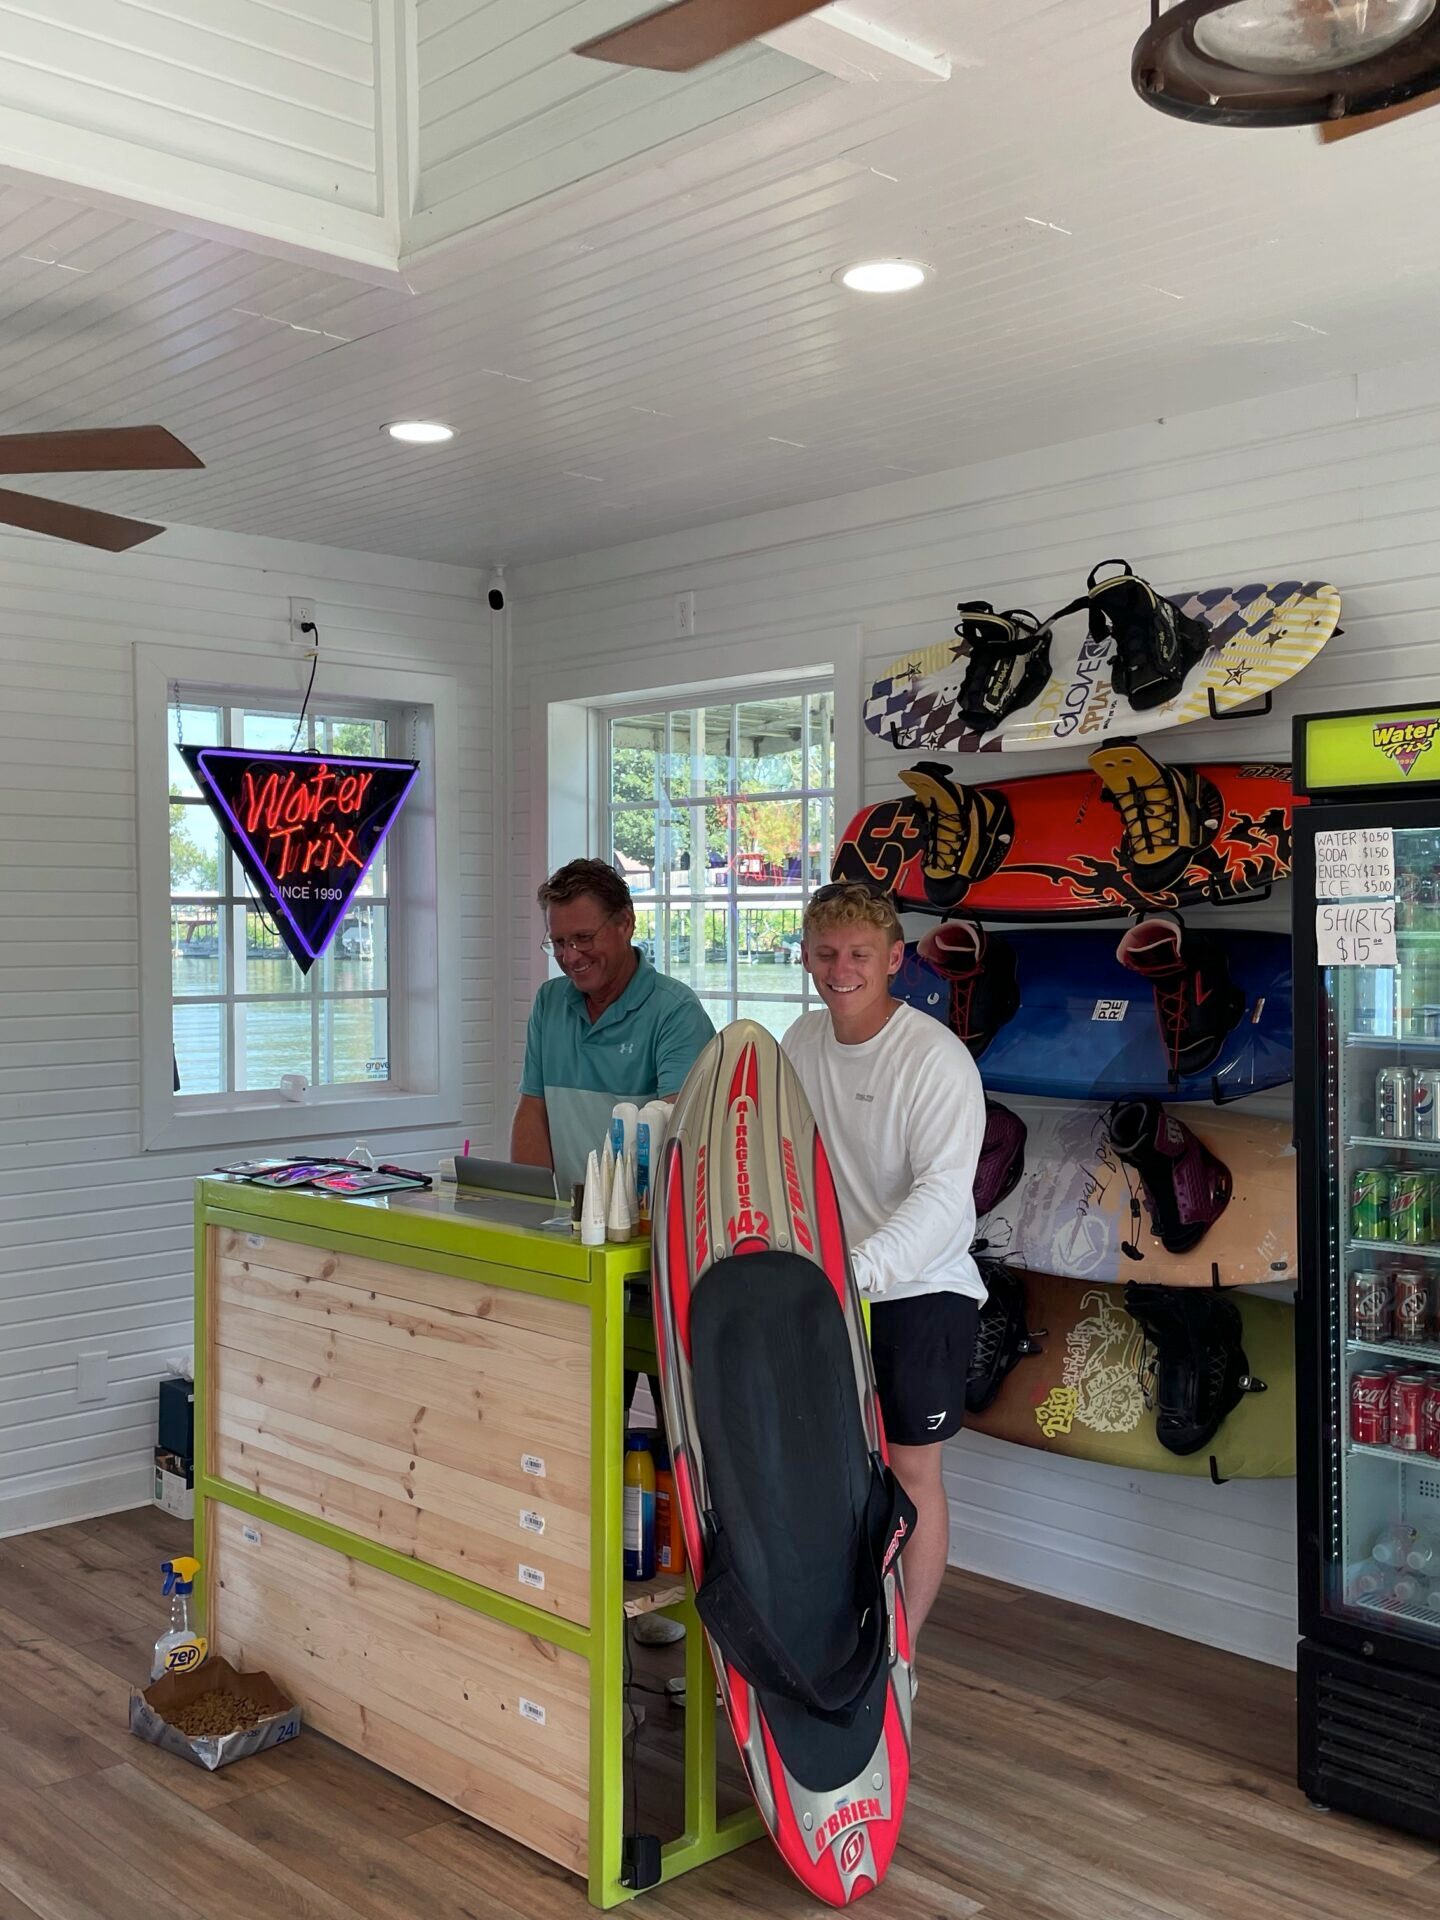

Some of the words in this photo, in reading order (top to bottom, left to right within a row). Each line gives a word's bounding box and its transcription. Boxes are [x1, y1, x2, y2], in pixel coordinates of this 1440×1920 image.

[1025, 678, 1071, 741] BODY
[1054, 660, 1101, 737] GLOVE
[1079, 681, 1112, 734] SPLAT
[1373, 722, 1438, 747] Water
[1382, 740, 1432, 758] Trix
[245, 763, 374, 832] Water
[269, 822, 364, 880] Trix
[1316, 832, 1357, 846] WATER
[1362, 831, 1389, 843] $0.50
[1318, 848, 1348, 862] SODA
[1318, 863, 1361, 879] ENERGY
[313, 887, 343, 900] 1990
[1319, 880, 1352, 897] ICE
[1323, 907, 1393, 934] SHIRTS
[1385, 1084, 1398, 1123] pepsi
[736, 1101, 754, 1209] AIRAGEOUS
[782, 1136, 814, 1255] O'BRIEN
[726, 1209, 770, 1244] 142
[276, 1722, 295, 1743] 24
[815, 1798, 883, 1853] O'BRIEN
